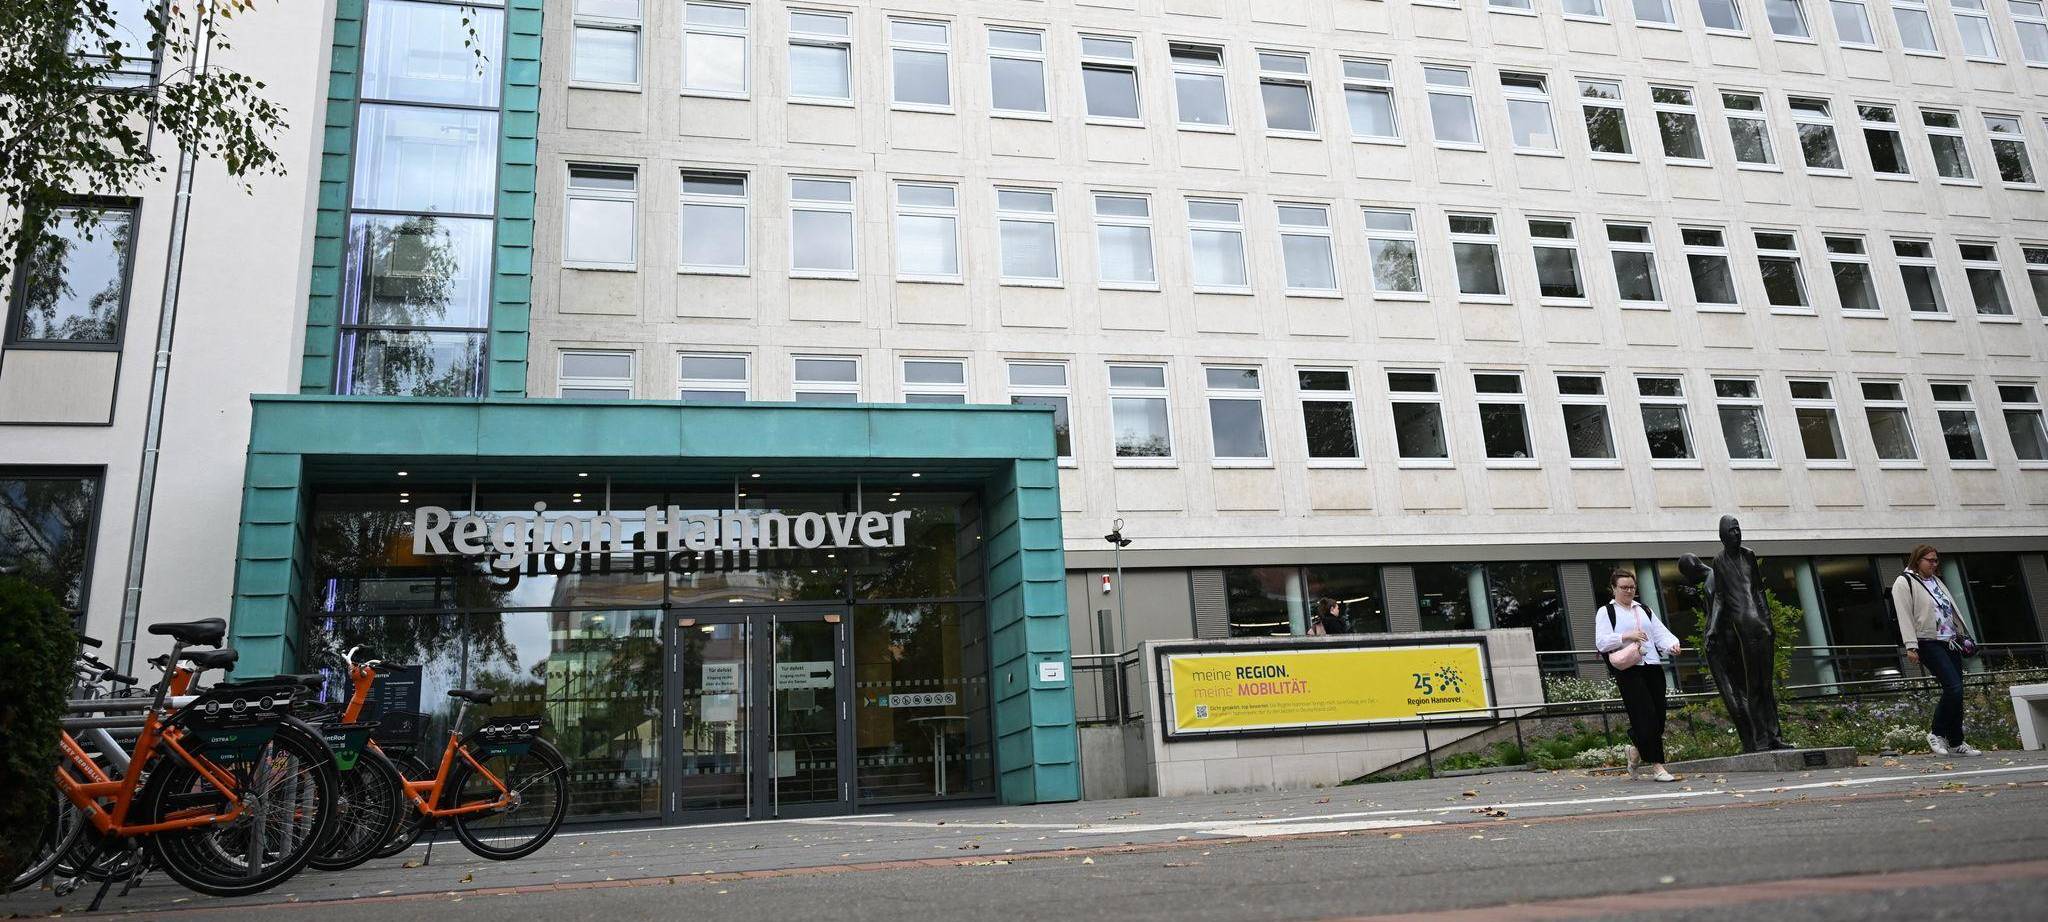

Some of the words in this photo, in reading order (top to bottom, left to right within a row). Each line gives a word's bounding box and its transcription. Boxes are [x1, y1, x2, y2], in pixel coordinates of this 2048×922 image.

[412, 501, 622, 569] Region
[644, 505, 911, 552] Hannover
[1192, 669, 1232, 682] meine
[1236, 664, 1290, 680] REGION.
[1194, 686, 1233, 698] meine
[1238, 678, 1311, 697] MOBILITÄT.
[1412, 673, 1433, 695] 25
[1407, 697, 1430, 706] Region
